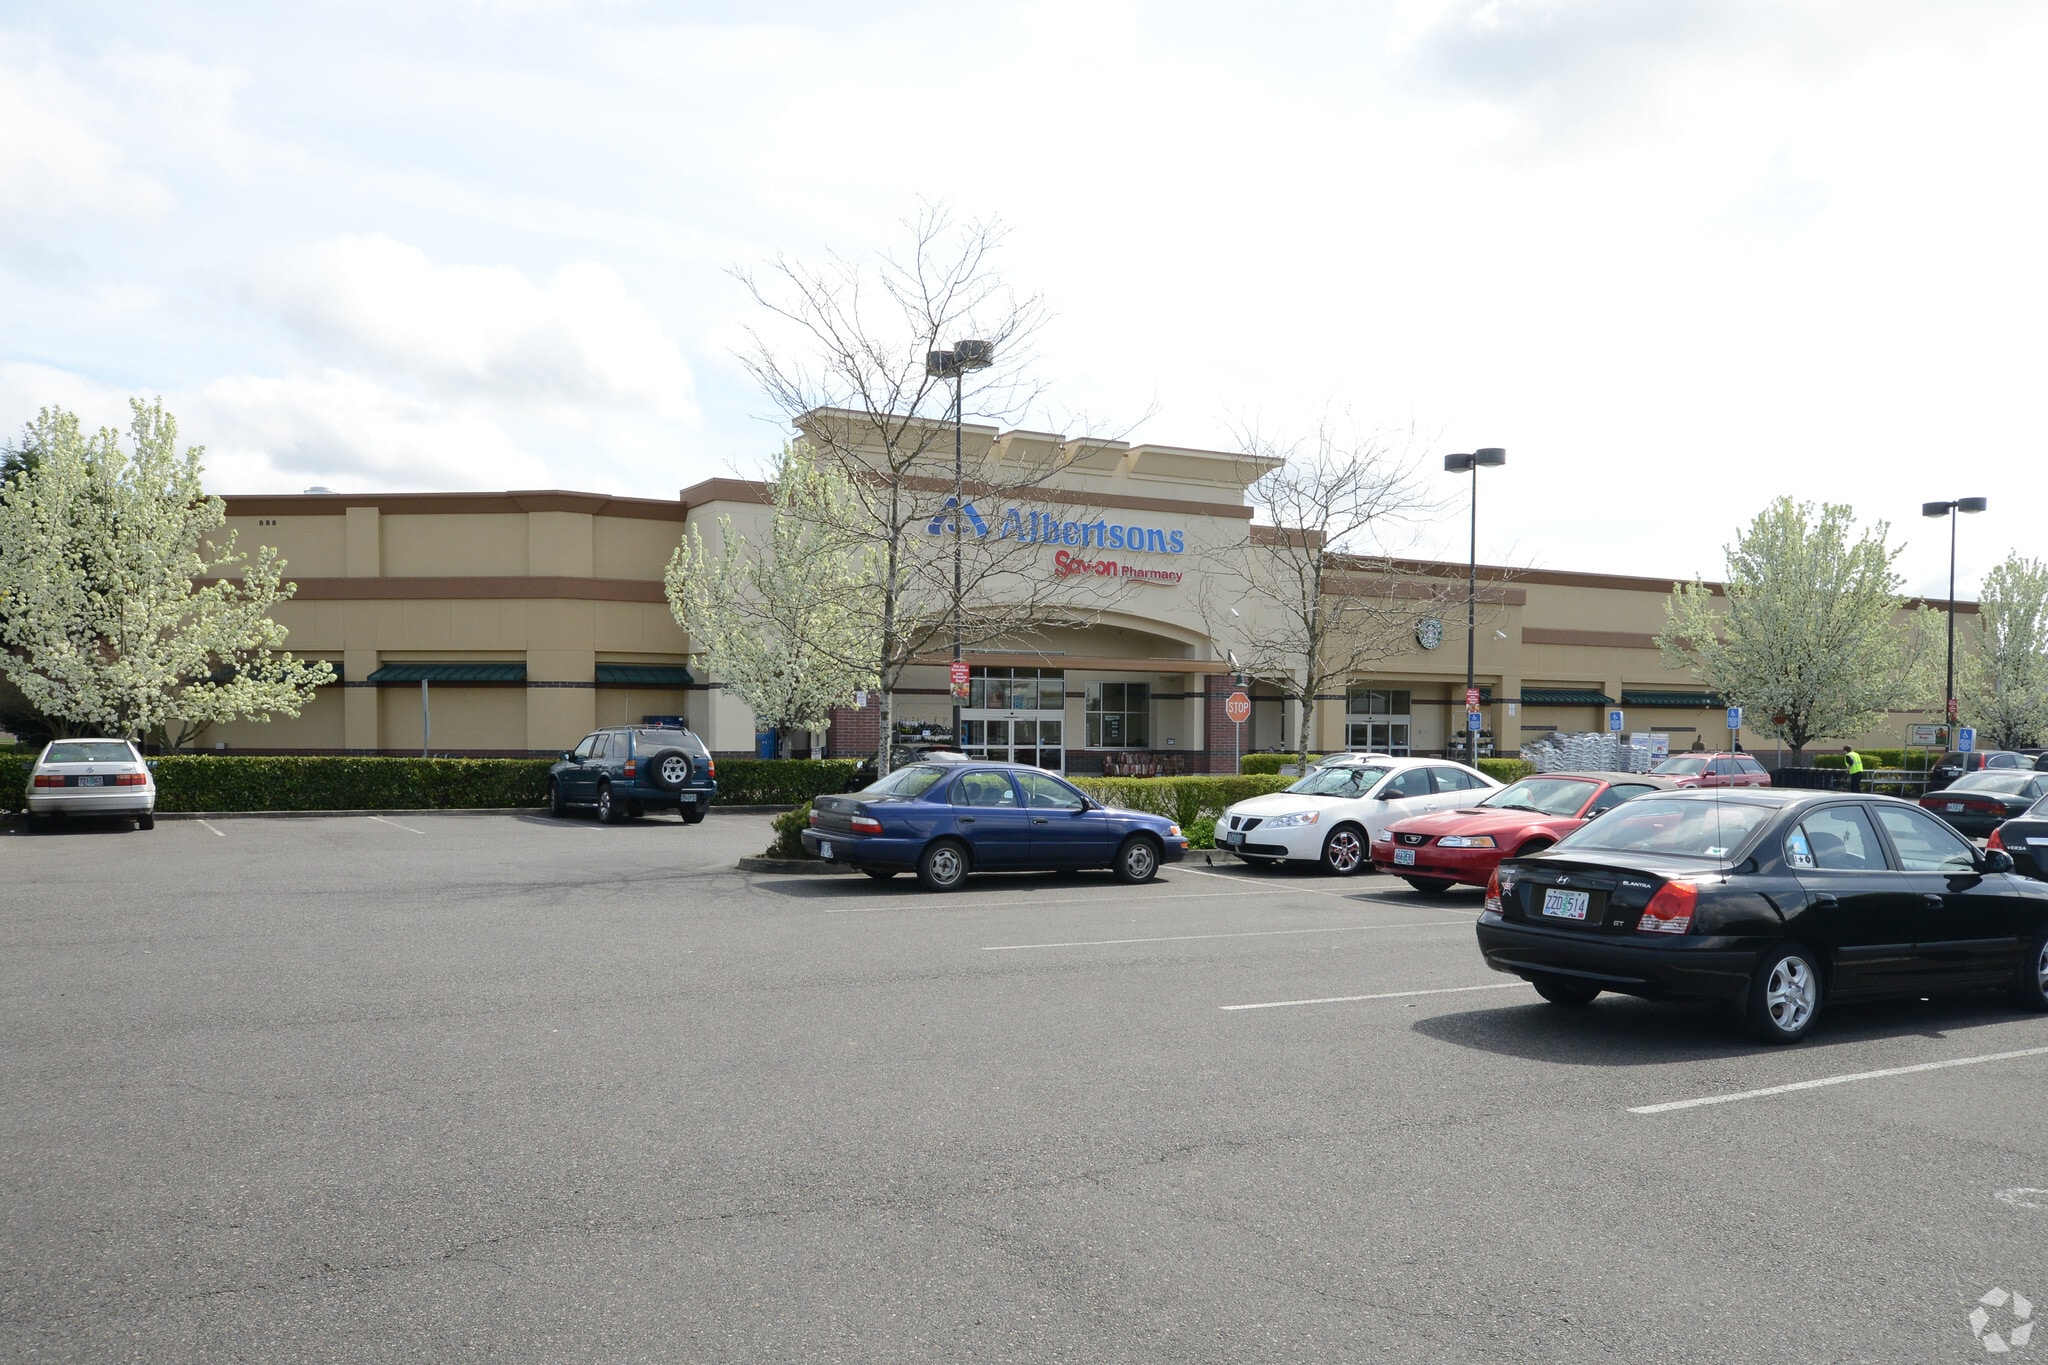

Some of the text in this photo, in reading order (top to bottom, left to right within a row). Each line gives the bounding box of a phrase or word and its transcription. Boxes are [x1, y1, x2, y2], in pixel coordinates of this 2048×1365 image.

[1000, 508, 1185, 554] Albertsons
[1121, 565, 1183, 583] Pharmacy
[1228, 701, 1249, 713] STOP
[1622, 880, 1652, 889] ELANTRA
[1567, 897, 1586, 913] 514
